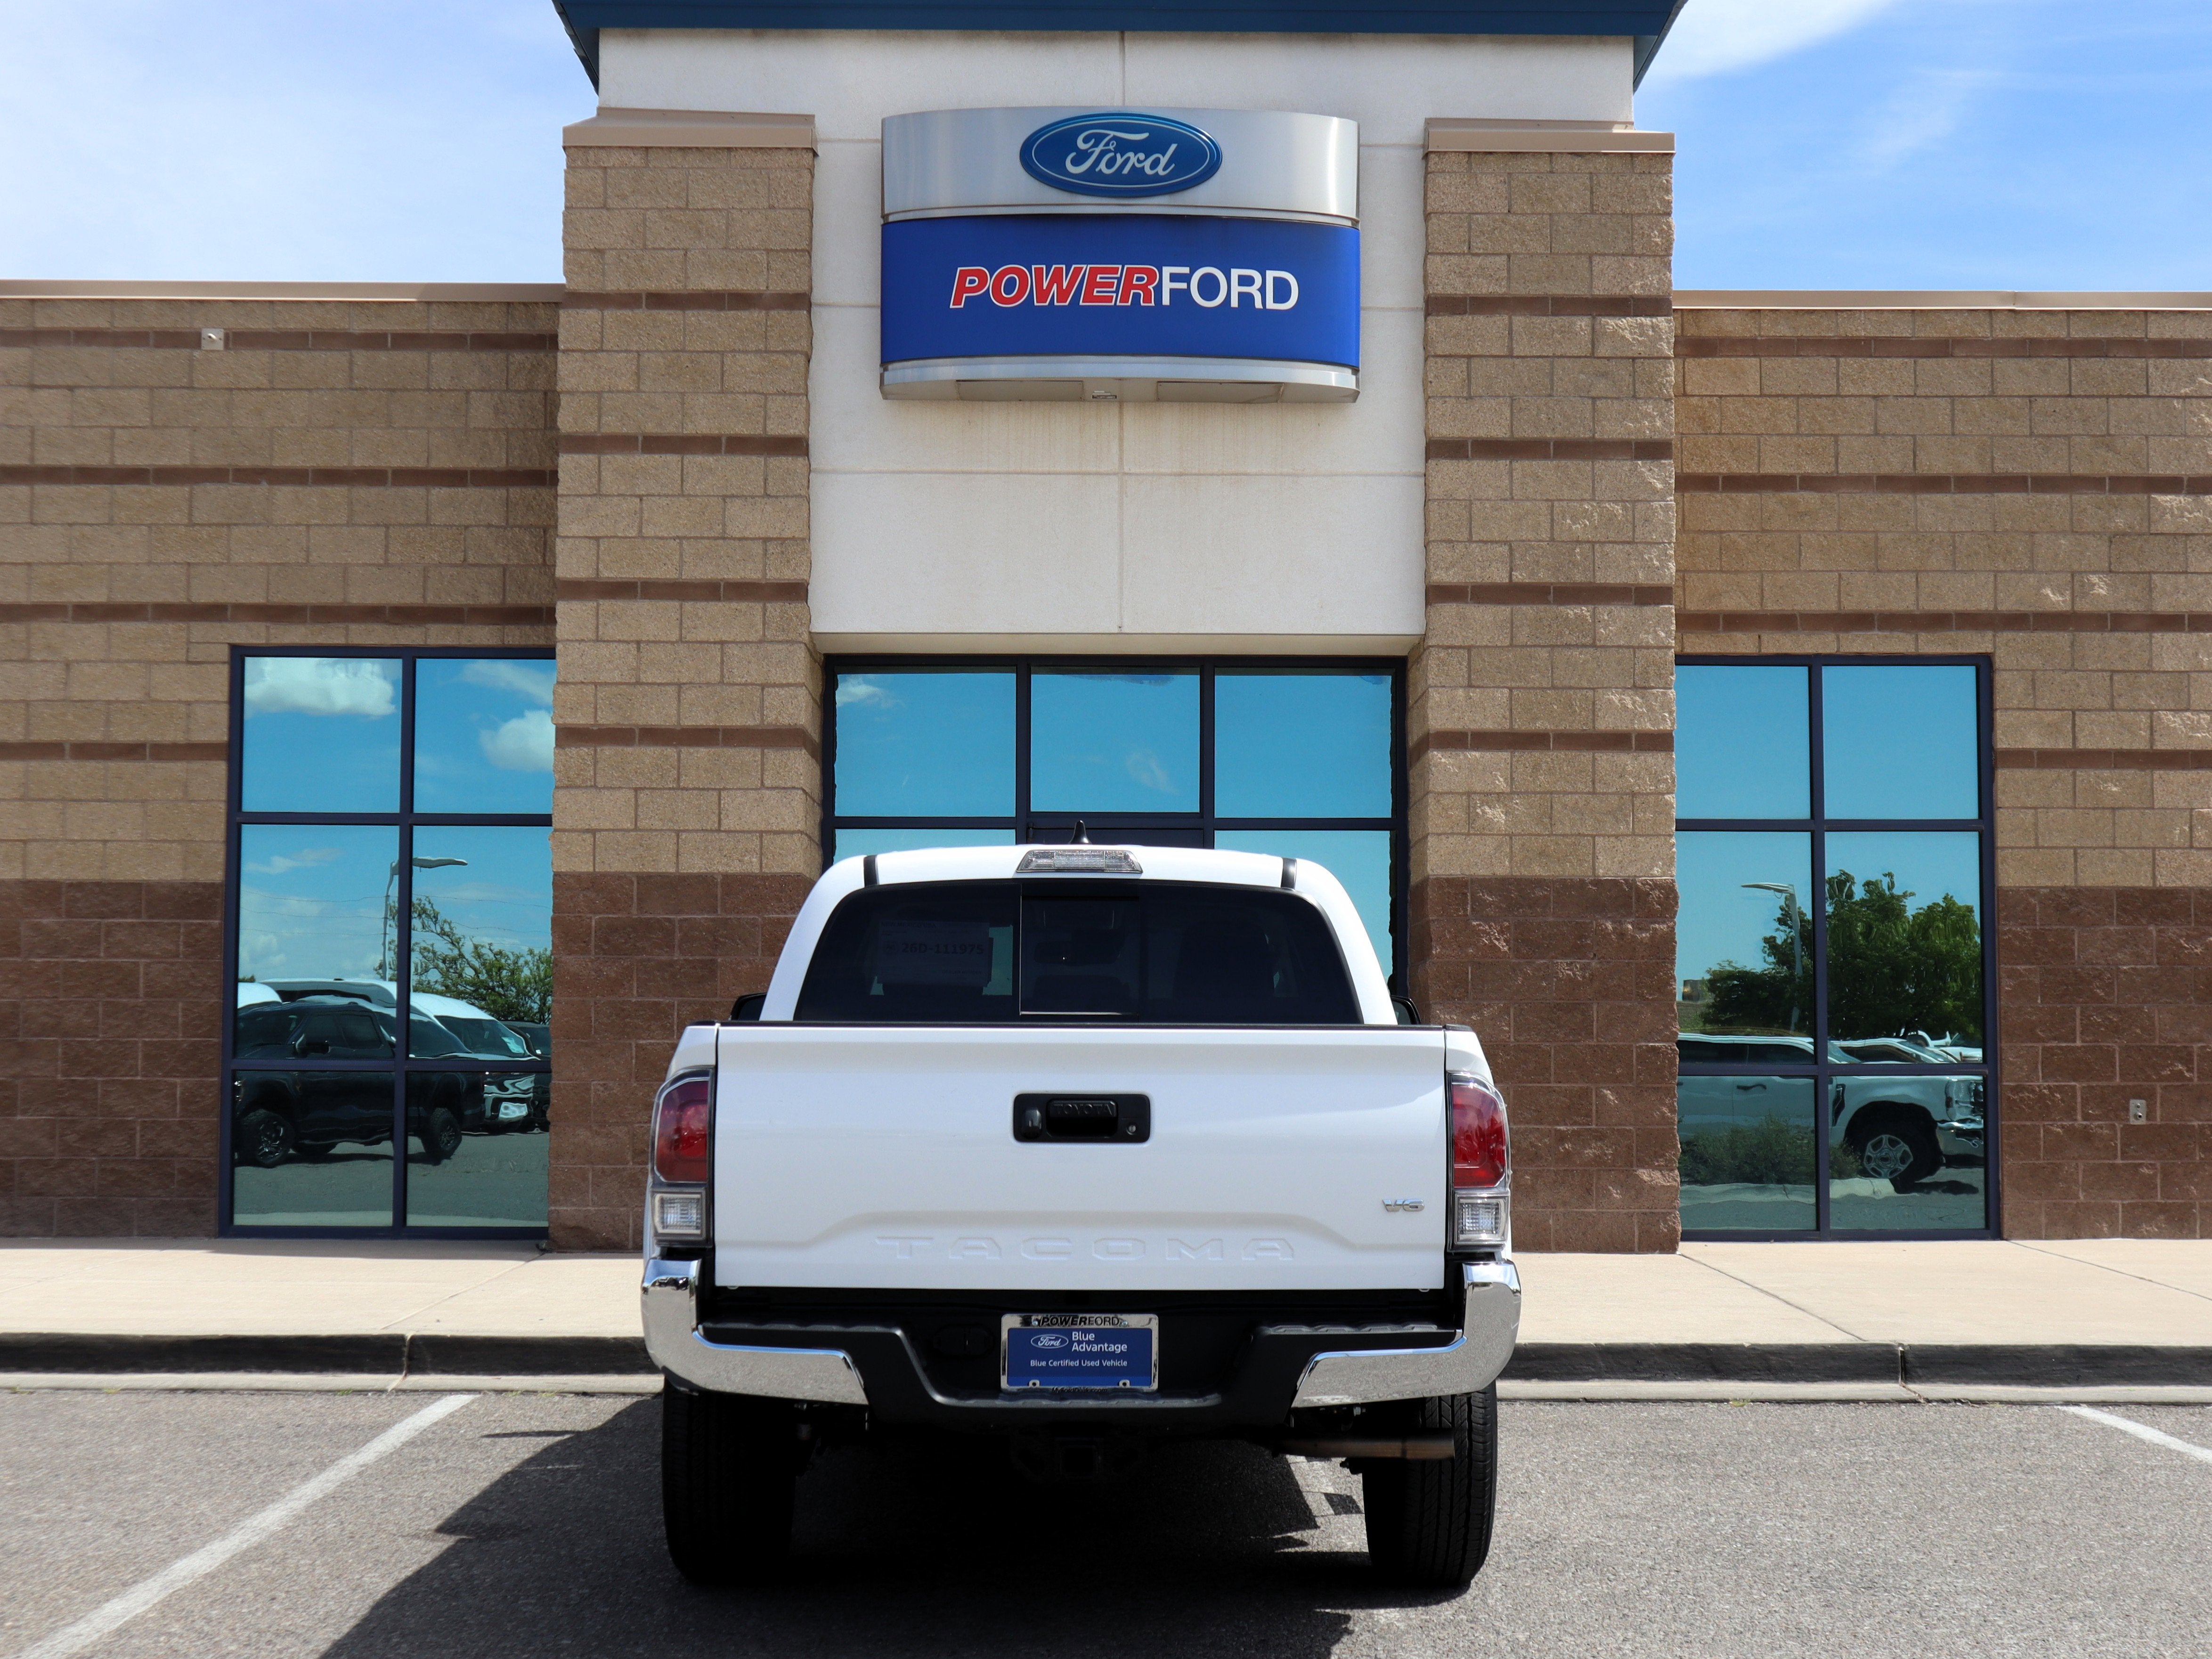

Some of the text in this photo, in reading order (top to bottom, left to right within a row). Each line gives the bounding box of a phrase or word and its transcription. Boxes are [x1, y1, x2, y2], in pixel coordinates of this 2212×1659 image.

[1065, 129, 1178, 176] Ford
[949, 264, 1299, 310] POWERFORD
[902, 942, 984, 954] 26D-111975
[1054, 1103, 1112, 1114] TOYOTA
[1382, 1199, 1424, 1212] V6
[874, 1236, 1295, 1261] TACOMA
[1040, 1316, 1120, 1326] POWERFORD
[1038, 1336, 1062, 1346] Ford
[1072, 1331, 1095, 1341] Blue
[1072, 1342, 1128, 1353] Advantage
